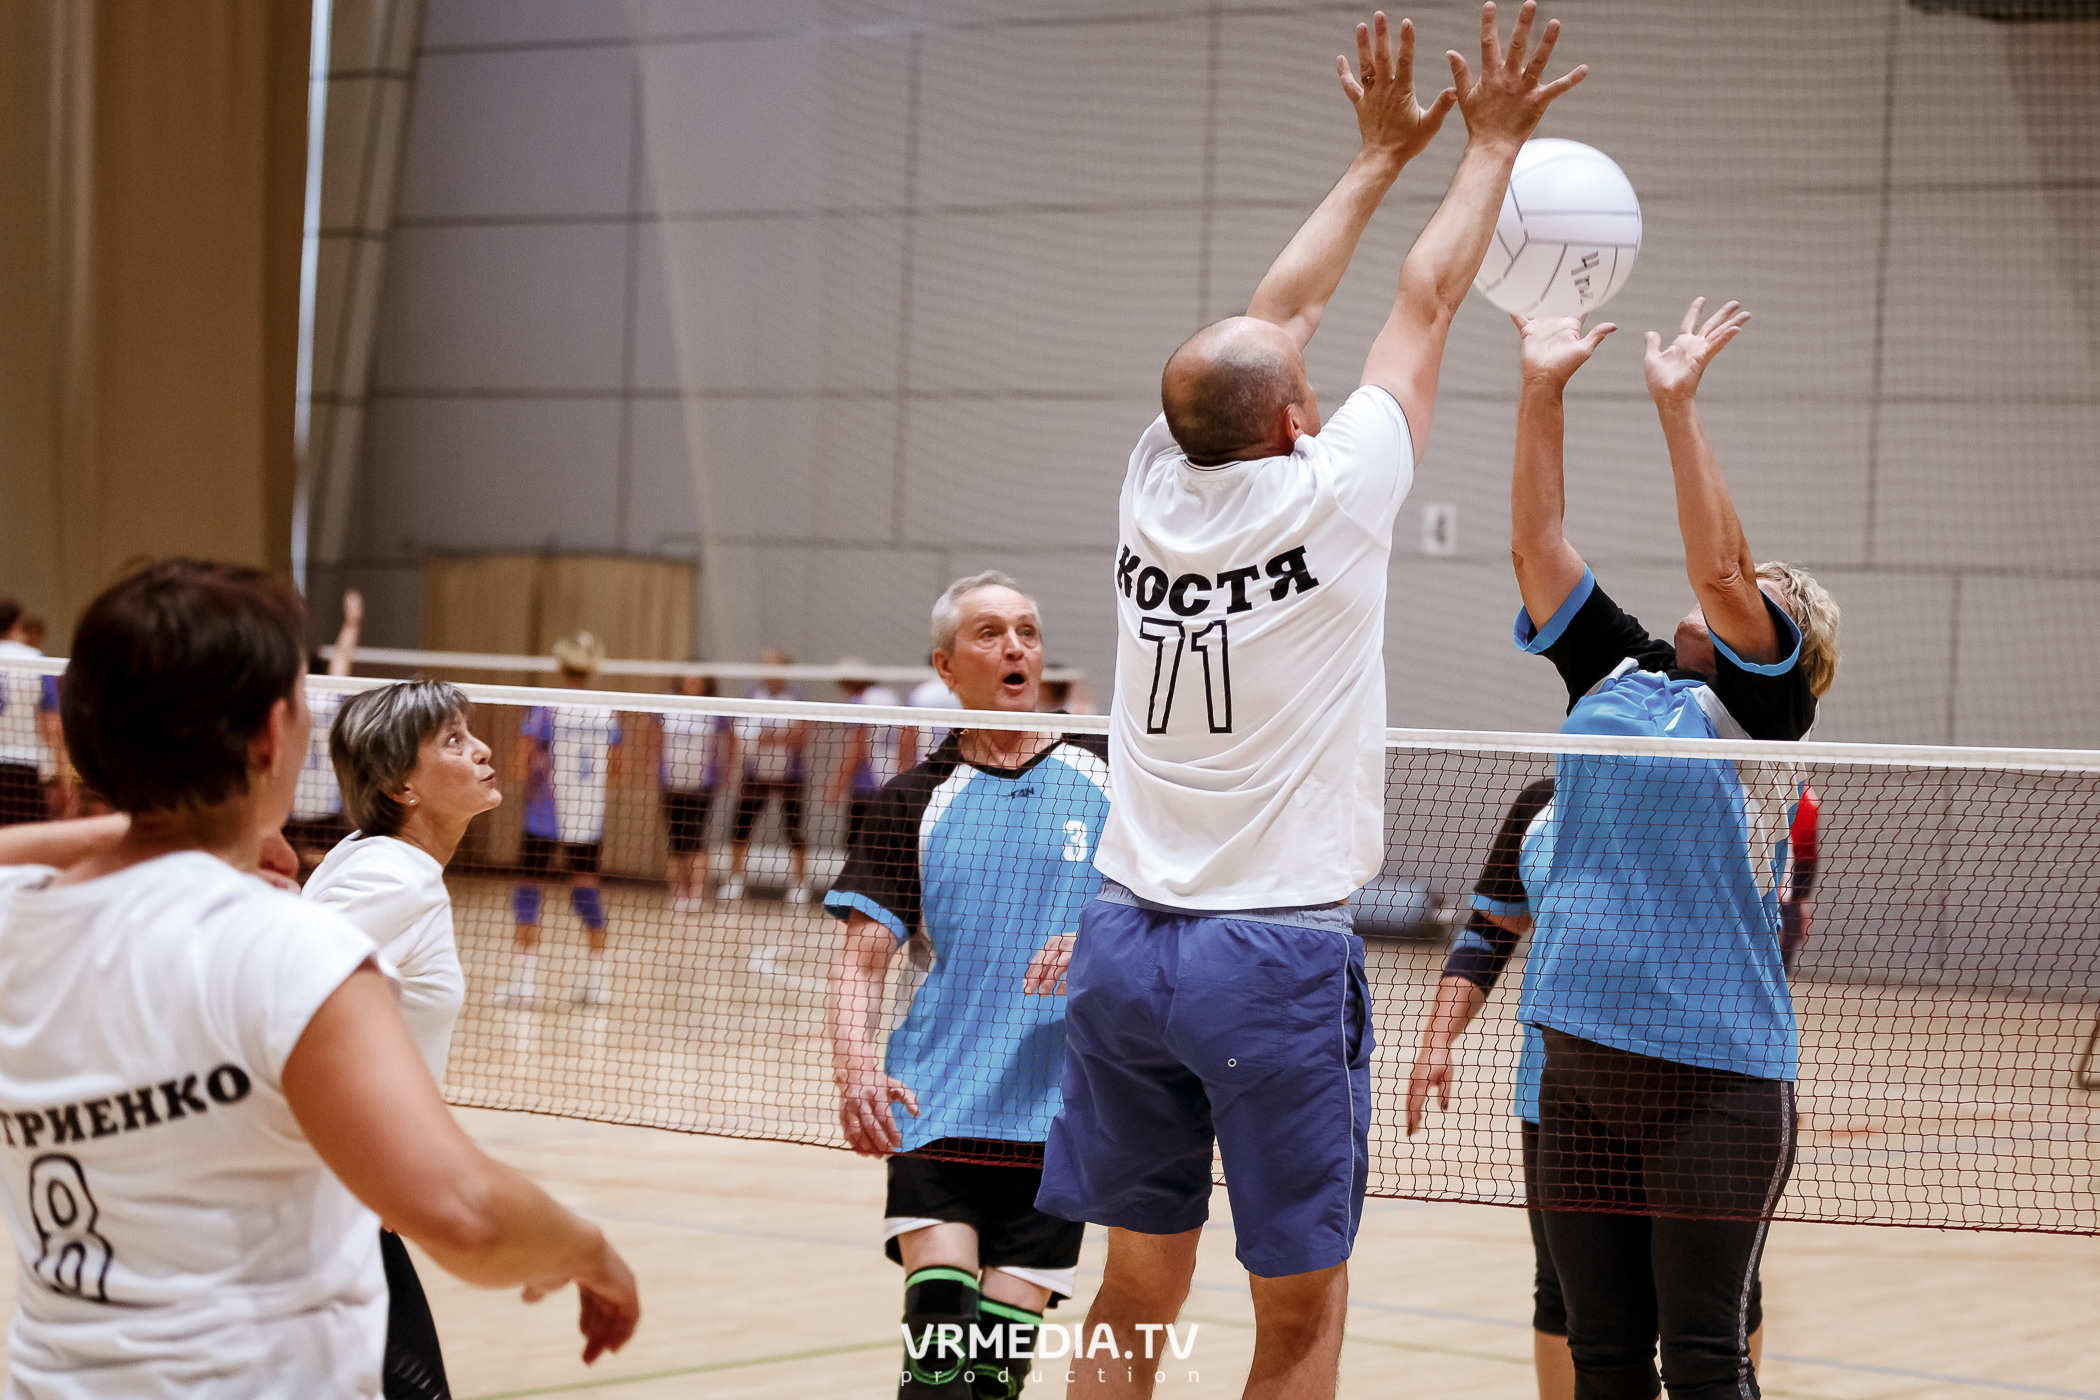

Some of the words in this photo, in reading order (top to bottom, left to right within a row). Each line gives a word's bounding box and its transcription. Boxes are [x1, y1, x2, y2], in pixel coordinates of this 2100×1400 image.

[1117, 544, 1320, 617] КОСТЯ
[1139, 616, 1233, 735] 71
[1062, 820, 1088, 862] 3
[28, 1153, 114, 1302] 8
